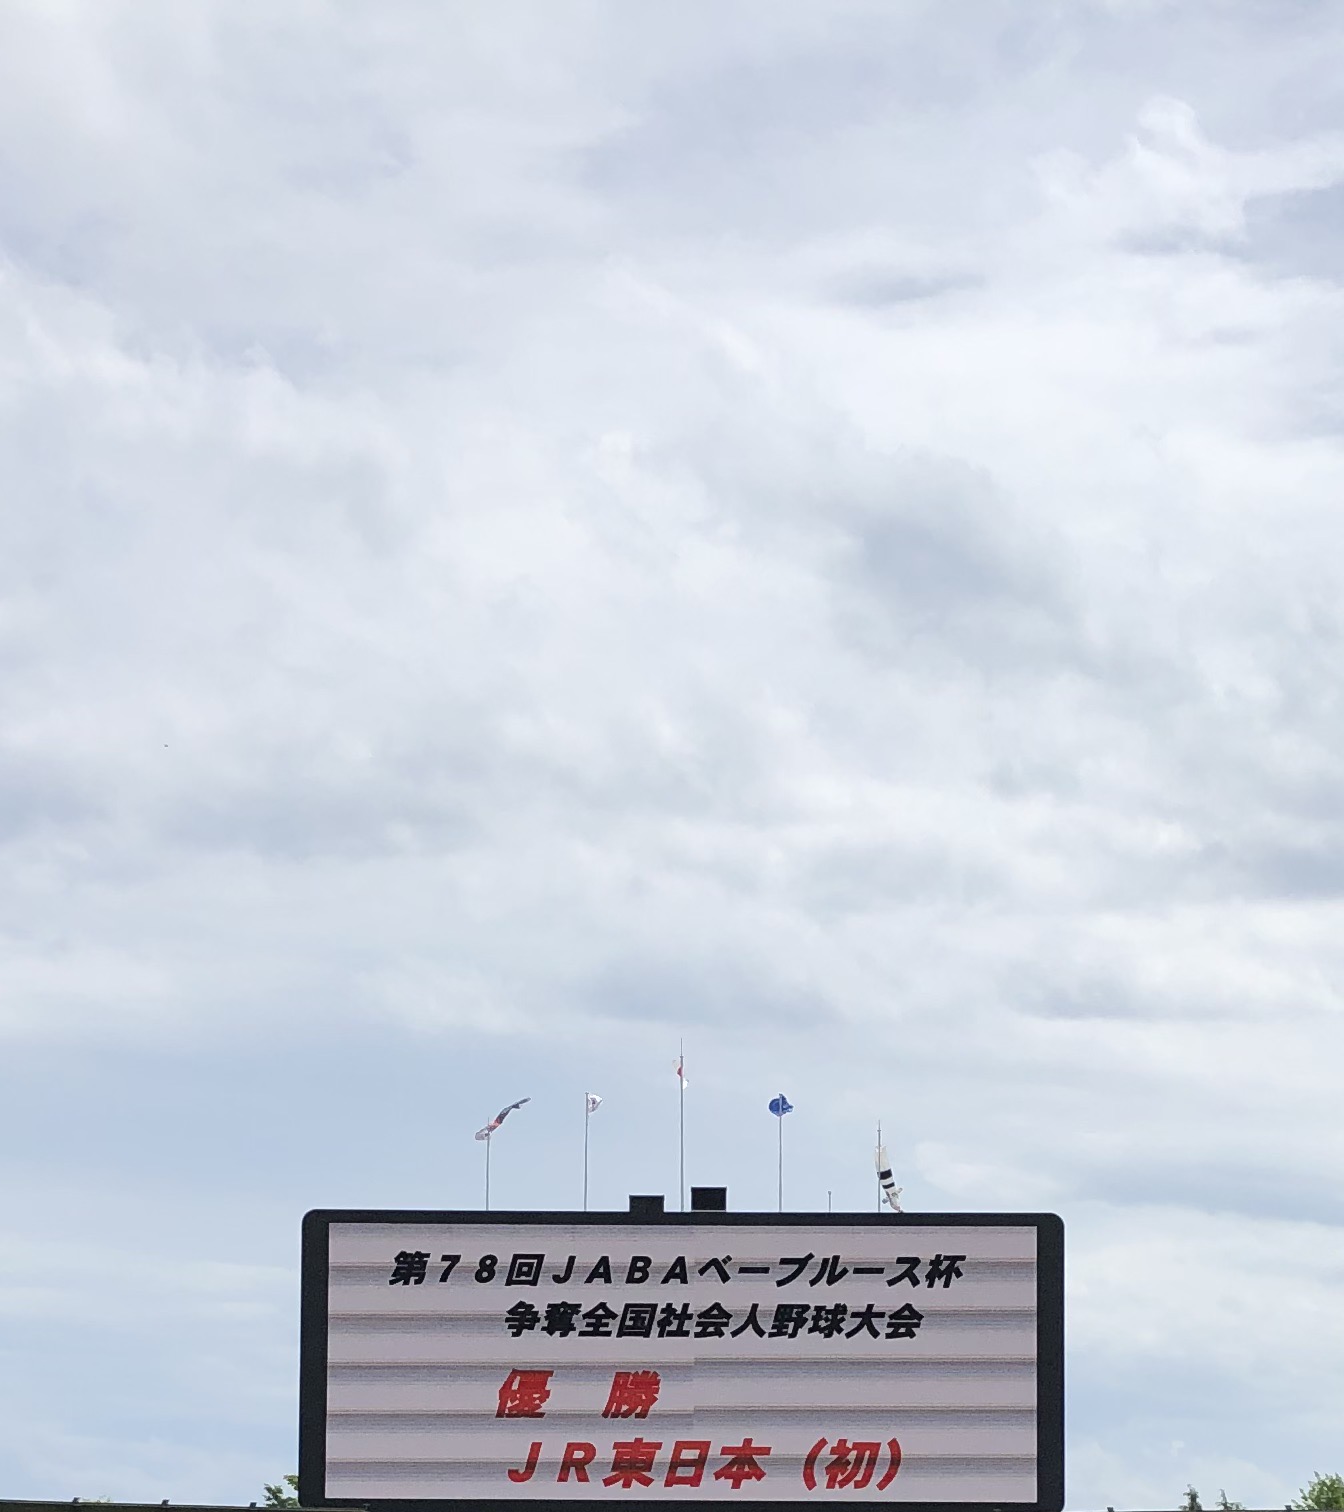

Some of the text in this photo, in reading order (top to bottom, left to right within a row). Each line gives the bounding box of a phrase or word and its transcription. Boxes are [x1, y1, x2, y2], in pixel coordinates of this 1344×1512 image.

[389, 1250, 965, 1287] 第78回JABAベーブルース杯
[504, 1302, 923, 1339] 争奪全国社会人野球大会
